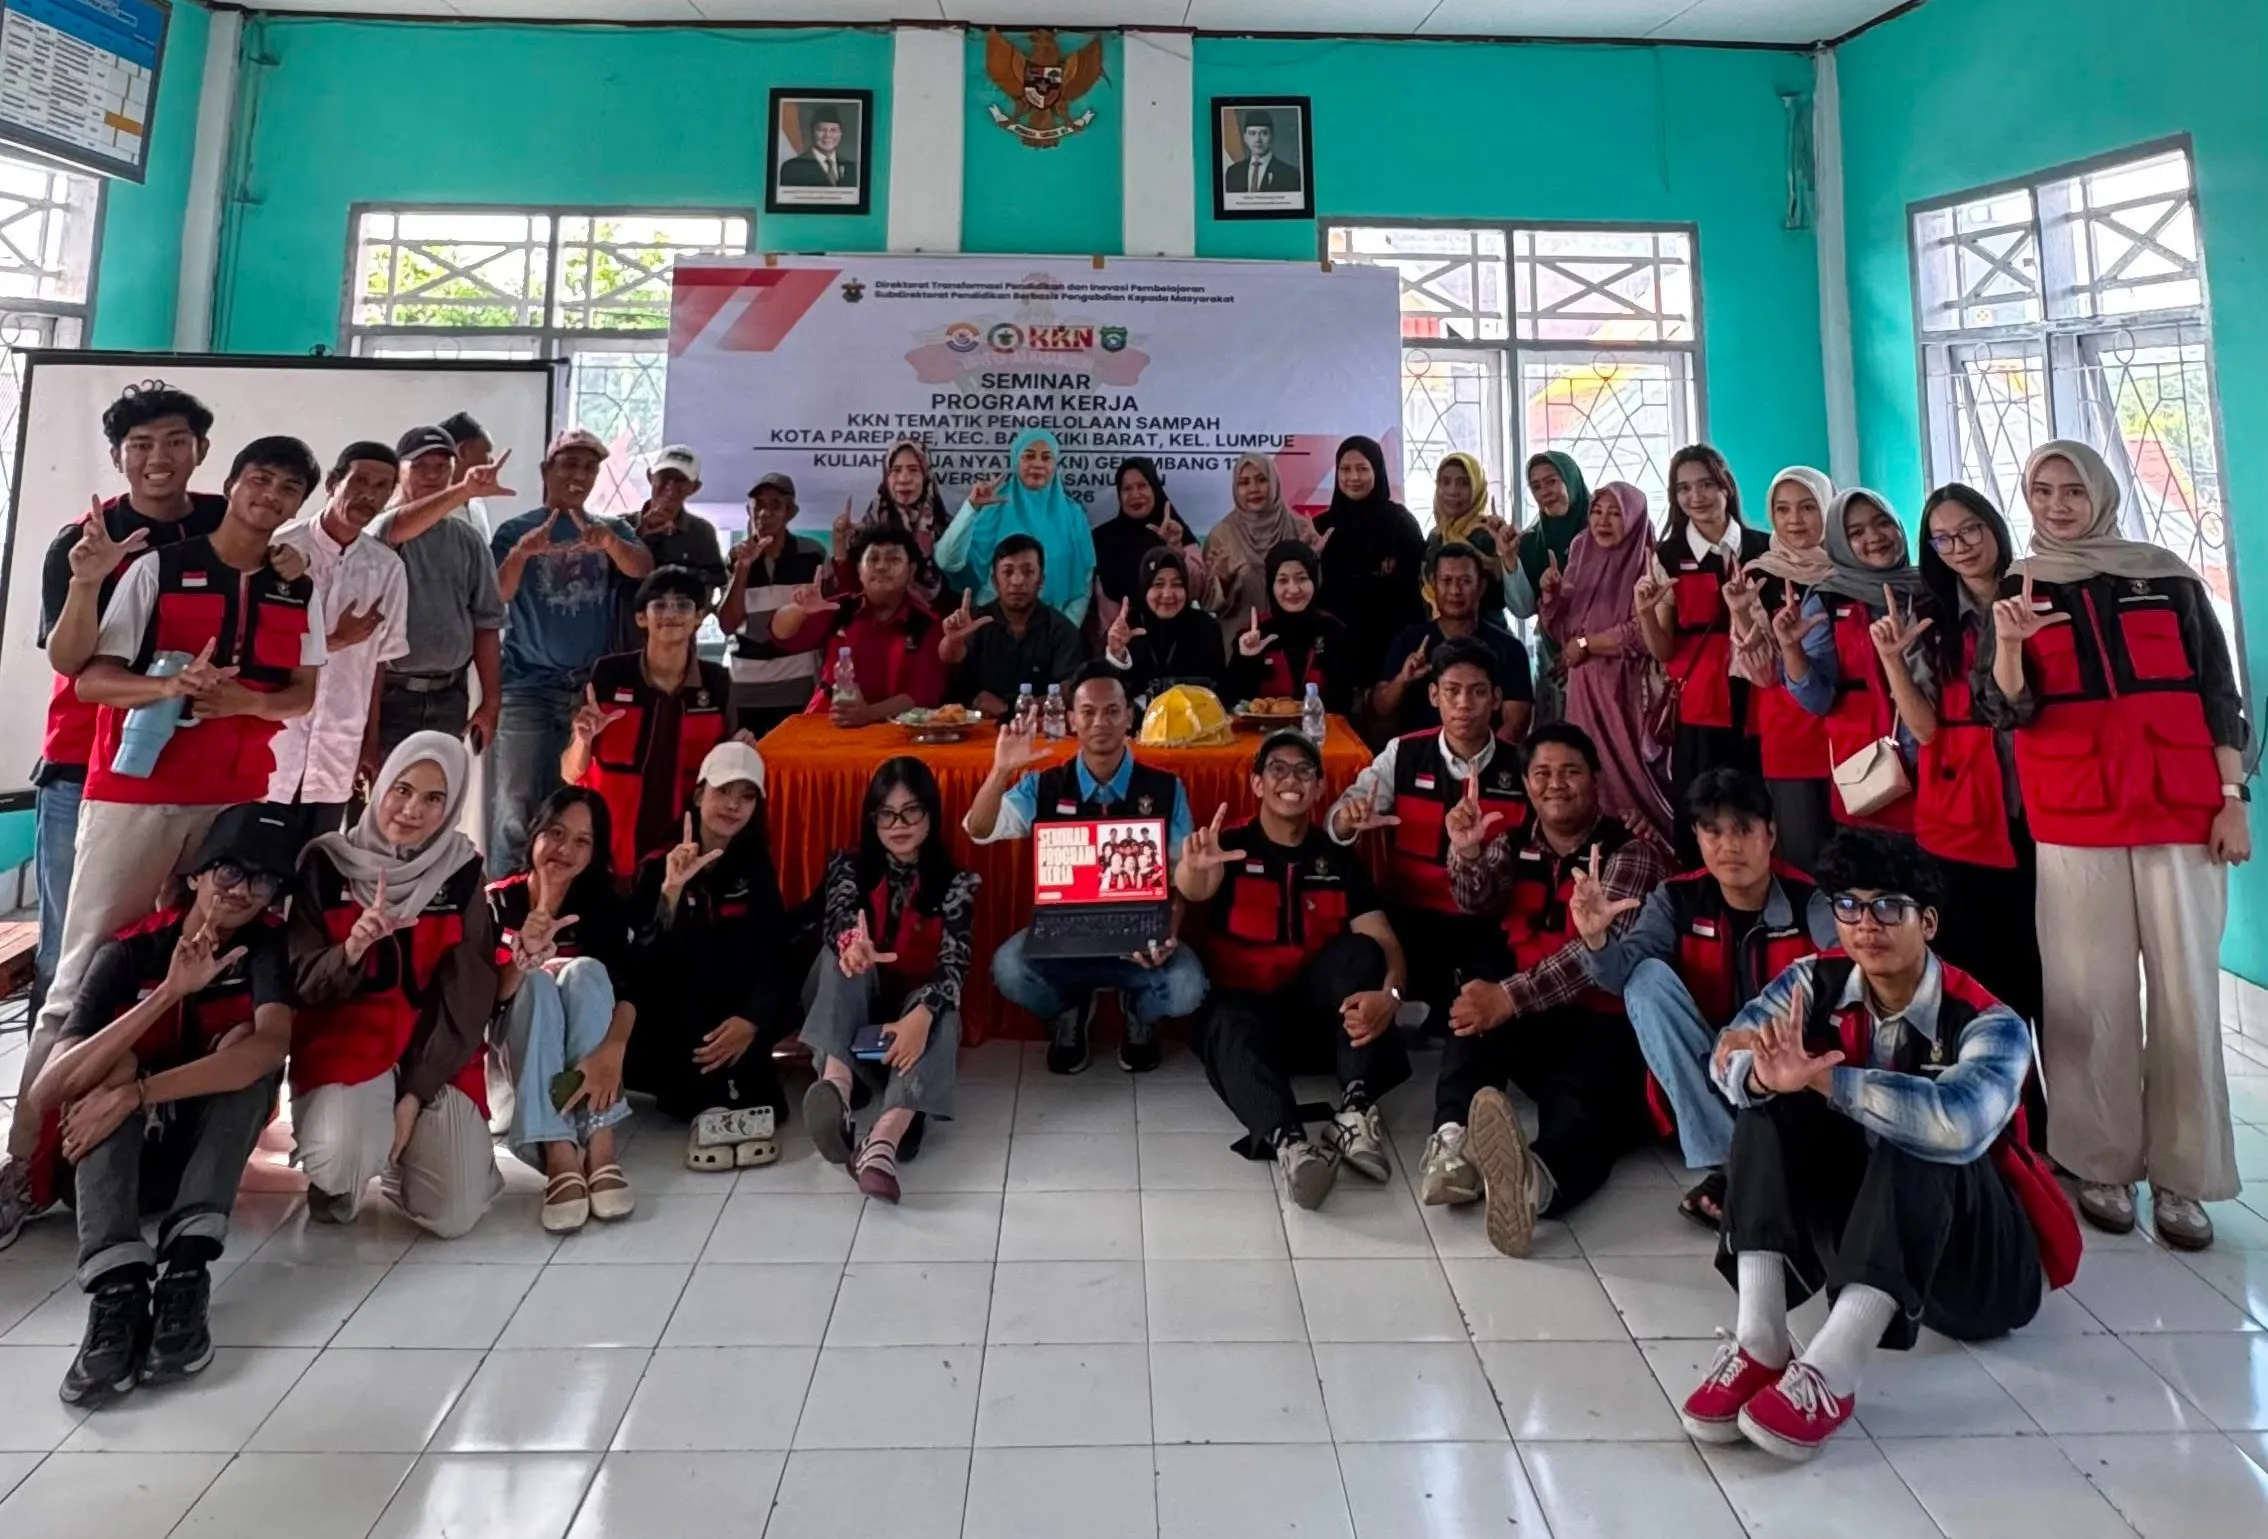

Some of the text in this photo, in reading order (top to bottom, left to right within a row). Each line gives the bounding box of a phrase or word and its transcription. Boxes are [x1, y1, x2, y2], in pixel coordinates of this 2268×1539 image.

[875, 280, 1205, 294] Direktorat Transformasi Pendidikan dan Inovasi Pembelajaran
[874, 289, 1235, 304] Subdirektorat Pendidikan Berbasis Pengabdian Kepada Masyarakat
[1029, 326, 1093, 349] KKN
[981, 373, 1091, 390] SEMINAR
[931, 393, 1139, 412] PROGRAM KERJA
[847, 413, 1220, 431] KKN TEMATIK PENGELOLAAN SAMPAH
[770, 429, 826, 444] KOTA
[945, 431, 991, 445] KEC.
[1092, 433, 1164, 449] BARAT,
[1169, 434, 1210, 448] KEL.
[1215, 434, 1295, 448] LUMPUE
[813, 453, 886, 468] KULIAH
[960, 455, 1012, 469] NYAT
